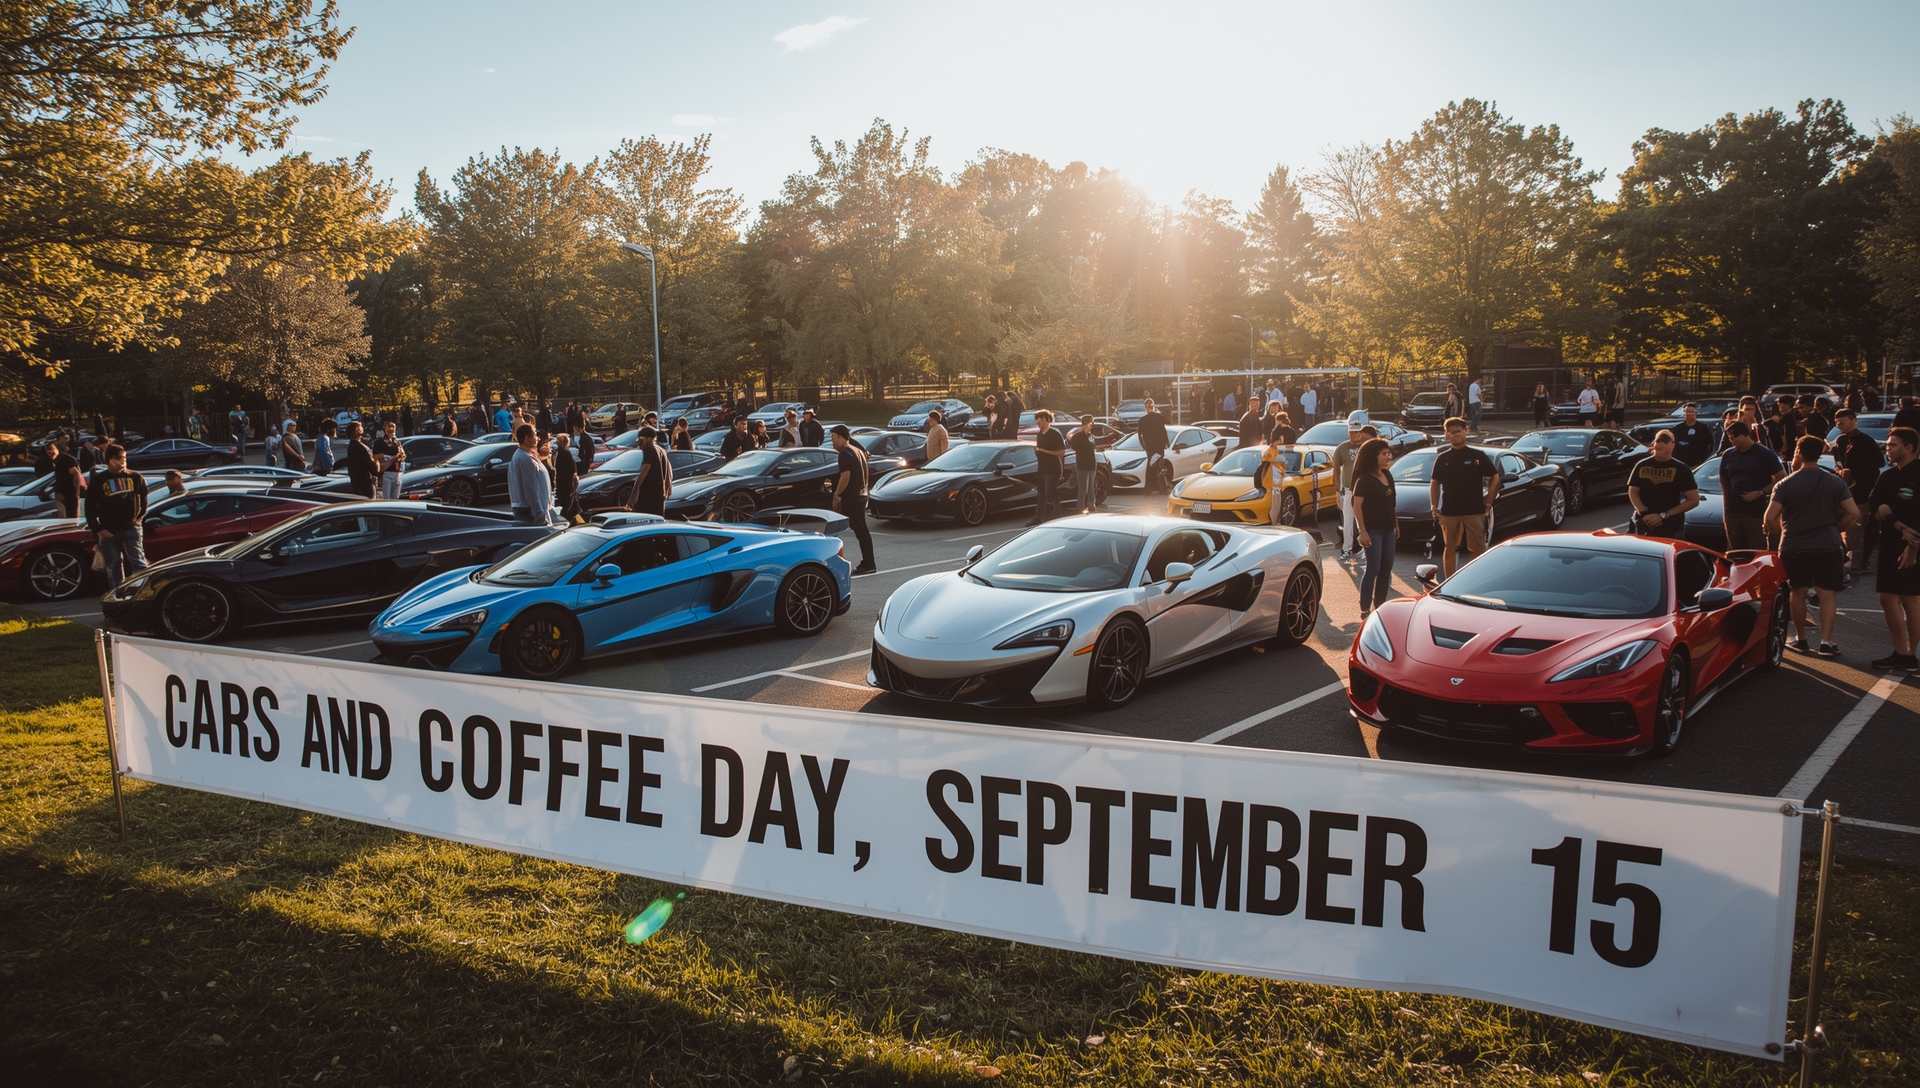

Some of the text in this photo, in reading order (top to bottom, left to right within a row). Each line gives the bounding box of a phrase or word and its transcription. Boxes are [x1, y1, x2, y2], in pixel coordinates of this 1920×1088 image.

[165, 674, 1663, 969] CARS AND COFFEE DAY, SEPTEMBER 15
